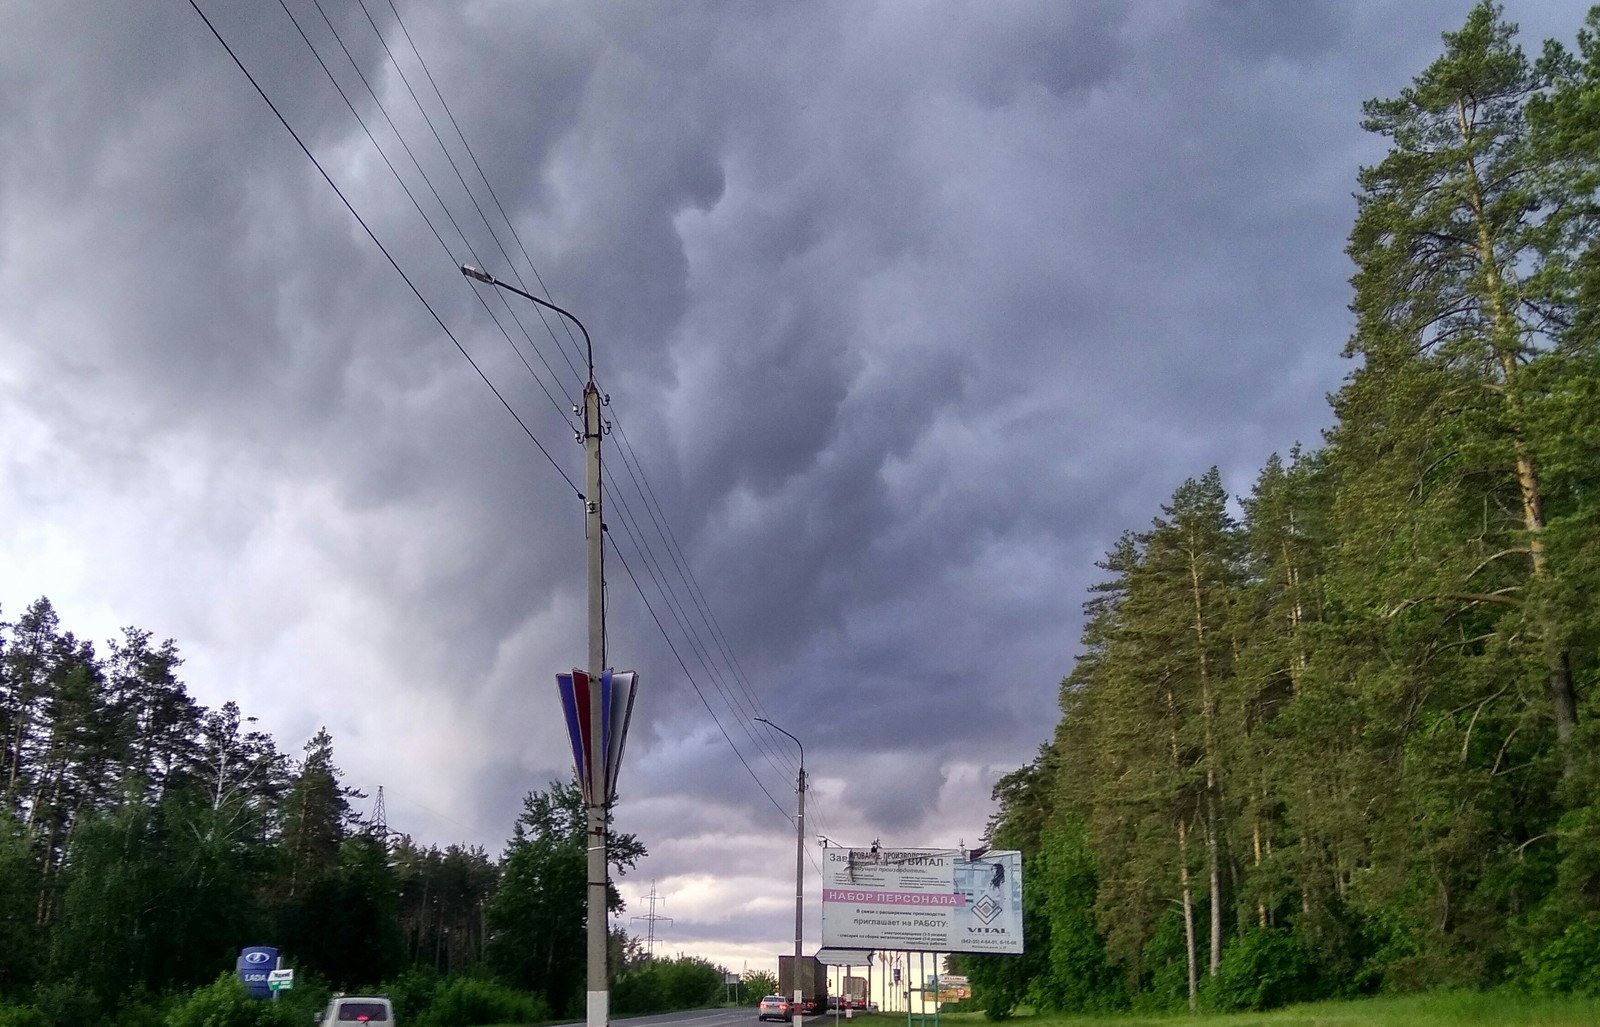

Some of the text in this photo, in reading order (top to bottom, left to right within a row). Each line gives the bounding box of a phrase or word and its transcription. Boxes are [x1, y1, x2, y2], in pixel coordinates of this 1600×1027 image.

[907, 857, 944, 866] ВИТАЛ
[829, 891, 958, 904] НАБОР ПЕРСОНАЛА
[853, 918, 900, 926] приглашает
[913, 919, 949, 928] РАБОТУ:
[244, 973, 266, 982] LADA
